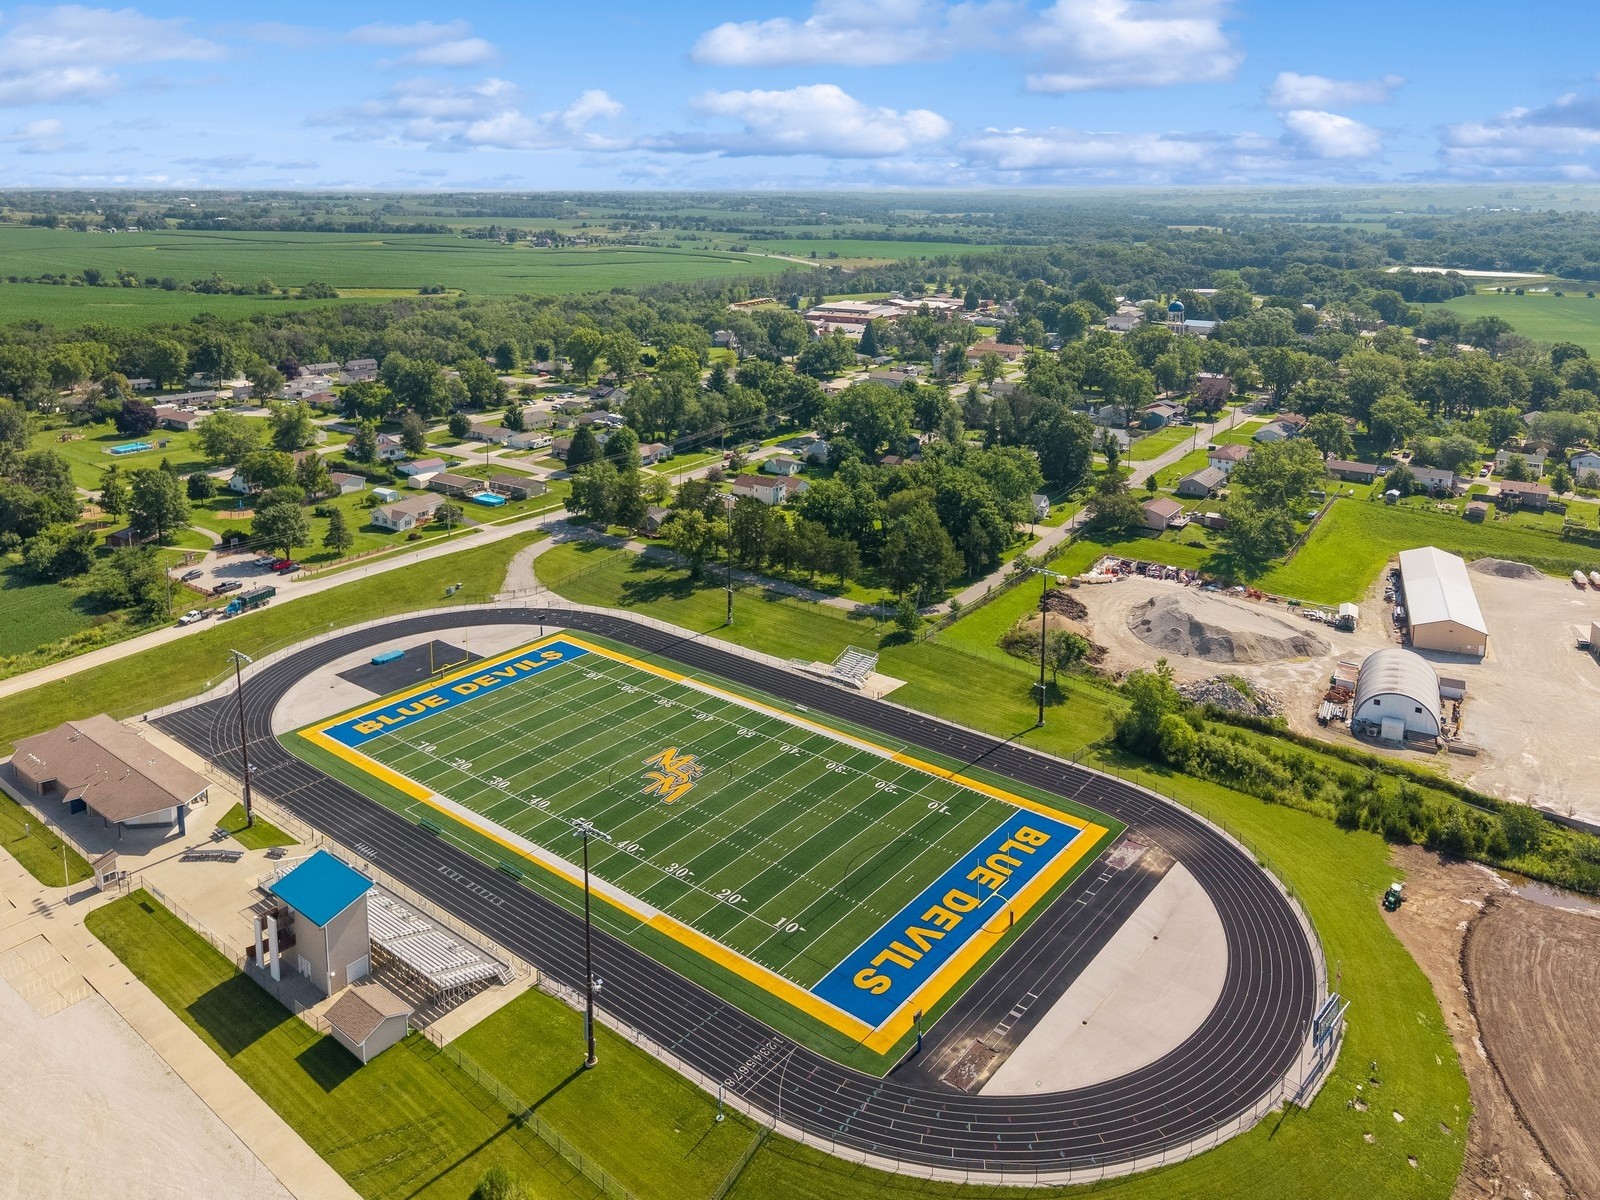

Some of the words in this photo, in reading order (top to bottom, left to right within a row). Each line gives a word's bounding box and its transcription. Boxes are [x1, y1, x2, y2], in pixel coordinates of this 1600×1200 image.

[352, 694, 449, 735] BLUE
[451, 650, 564, 695] DEVILS
[737, 729, 756, 738] 50
[419, 741, 437, 754] 10
[780, 745, 800, 755] 40
[451, 758, 472, 770] 20
[826, 762, 847, 773] 30
[490, 776, 510, 788] 30
[875, 781, 898, 793] 20
[530, 797, 551, 809] 40
[927, 801, 950, 814] 10
[616, 840, 640, 853] 40
[965, 826, 1051, 890] BLUE
[664, 863, 689, 877] 30
[715, 889, 742, 904] 20
[772, 917, 799, 933] 10
[853, 888, 981, 995] DEVILS
[766, 1042, 777, 1050] 2
[772, 1036, 784, 1044] 1
[752, 1054, 763, 1062] 4
[759, 1048, 771, 1056] 3
[738, 1066, 750, 1074] 6
[745, 1060, 757, 1068] 5
[724, 1078, 736, 1087] 8
[733, 1072, 743, 1081] 7
